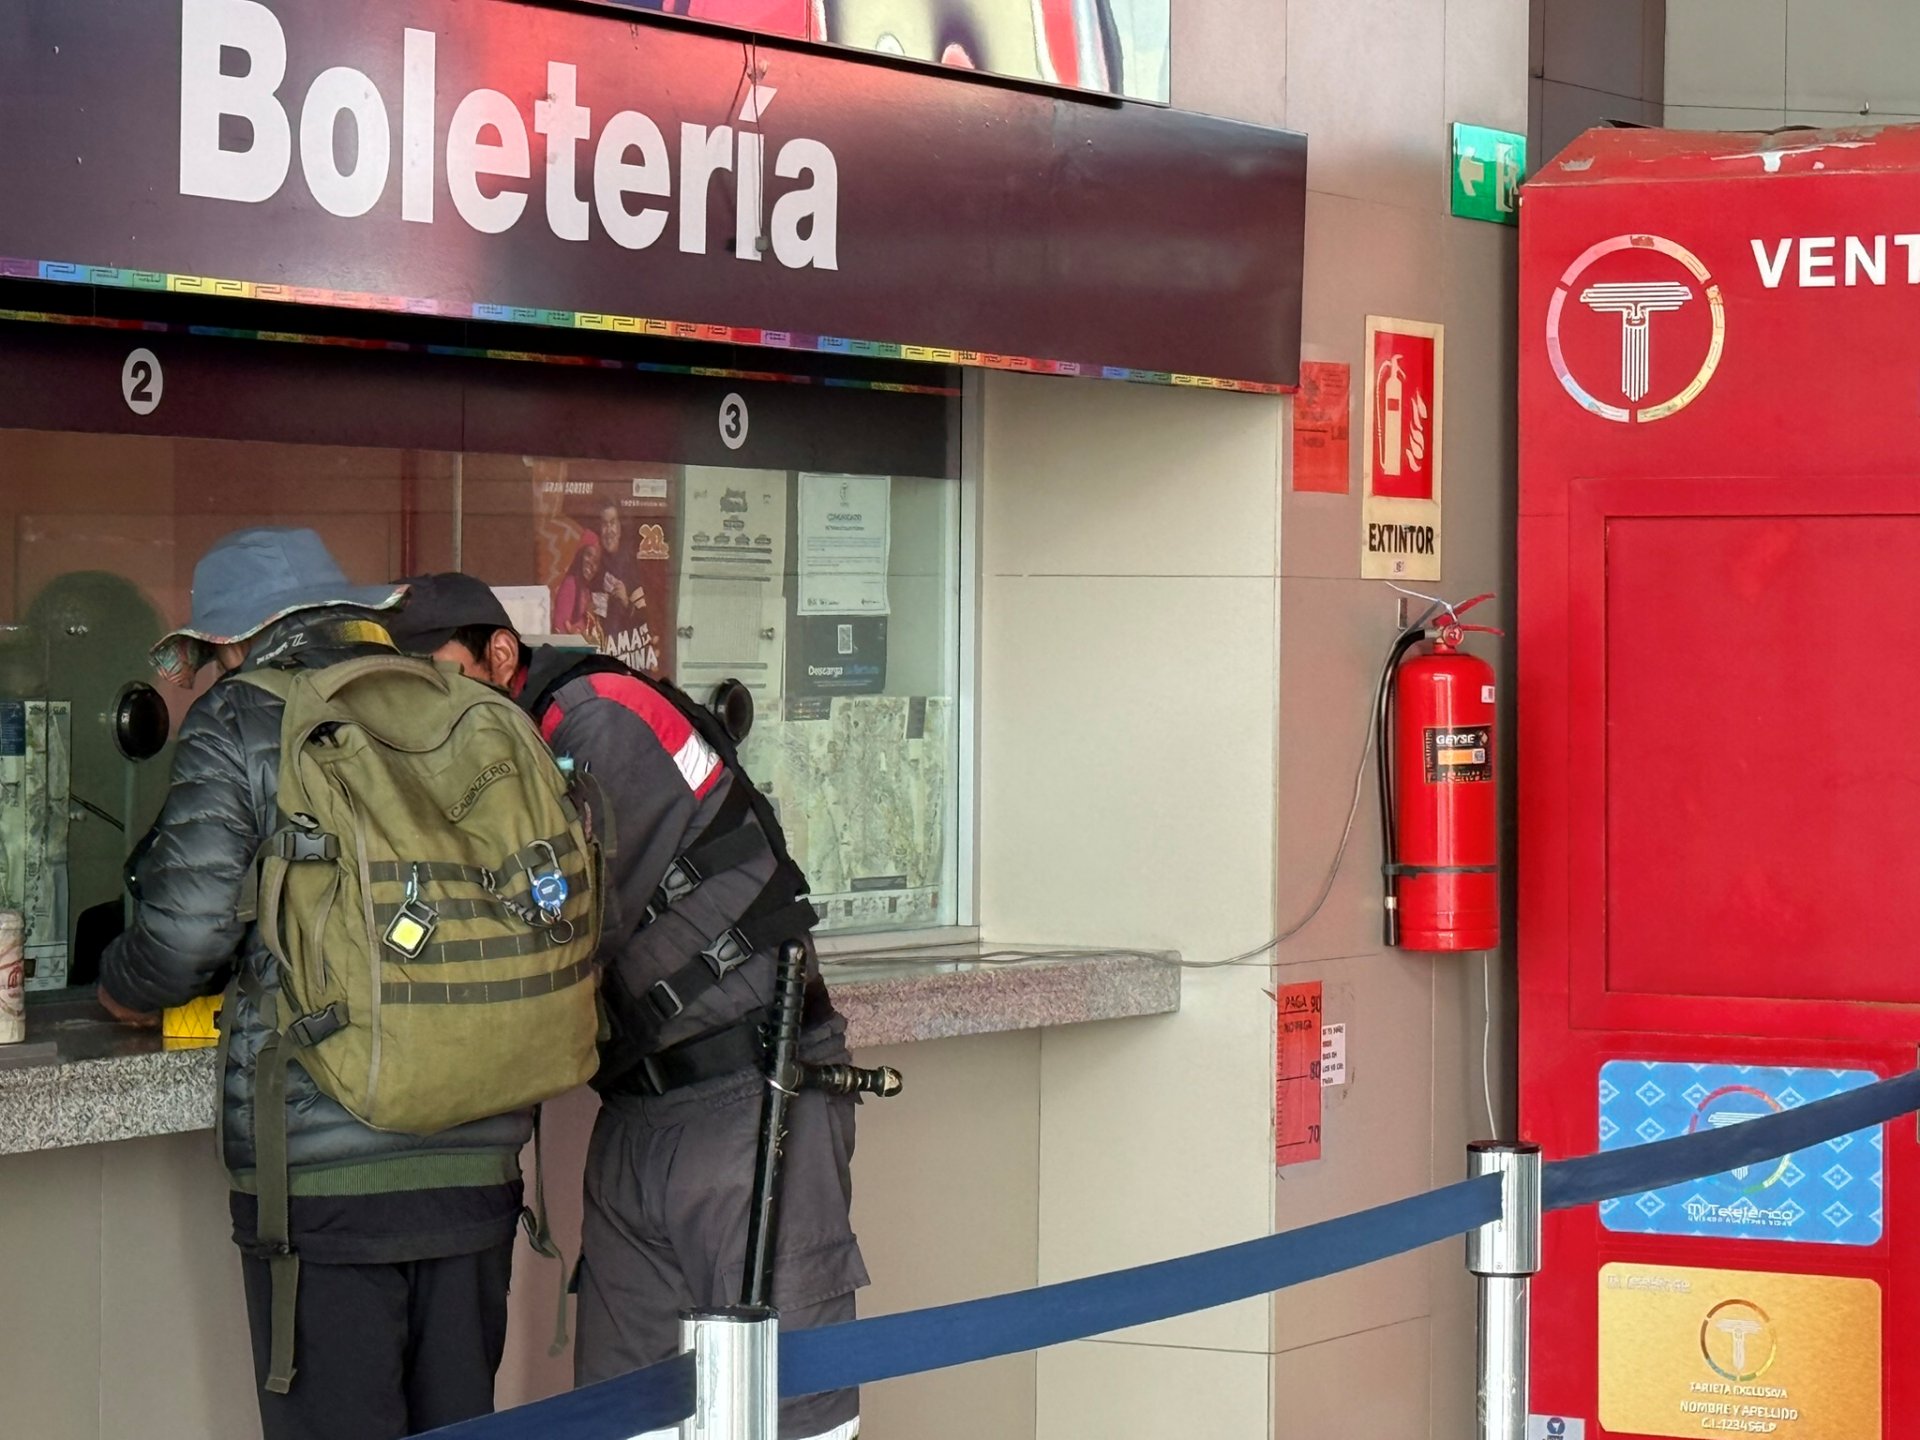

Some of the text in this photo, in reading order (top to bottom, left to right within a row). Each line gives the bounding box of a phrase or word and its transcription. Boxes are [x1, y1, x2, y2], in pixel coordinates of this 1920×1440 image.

[178, 0, 840, 271] Boletería
[130, 360, 153, 402] 2
[725, 402, 742, 439] 3
[1368, 522, 1435, 556] EXTINTOR
[808, 664, 844, 678] Descarga
[1435, 733, 1477, 746] GEYSE
[450, 761, 512, 819] CABINZERO
[1307, 1124, 1321, 1144] 70
[1679, 1400, 1799, 1421] NOMBRE Y APELLIDO
